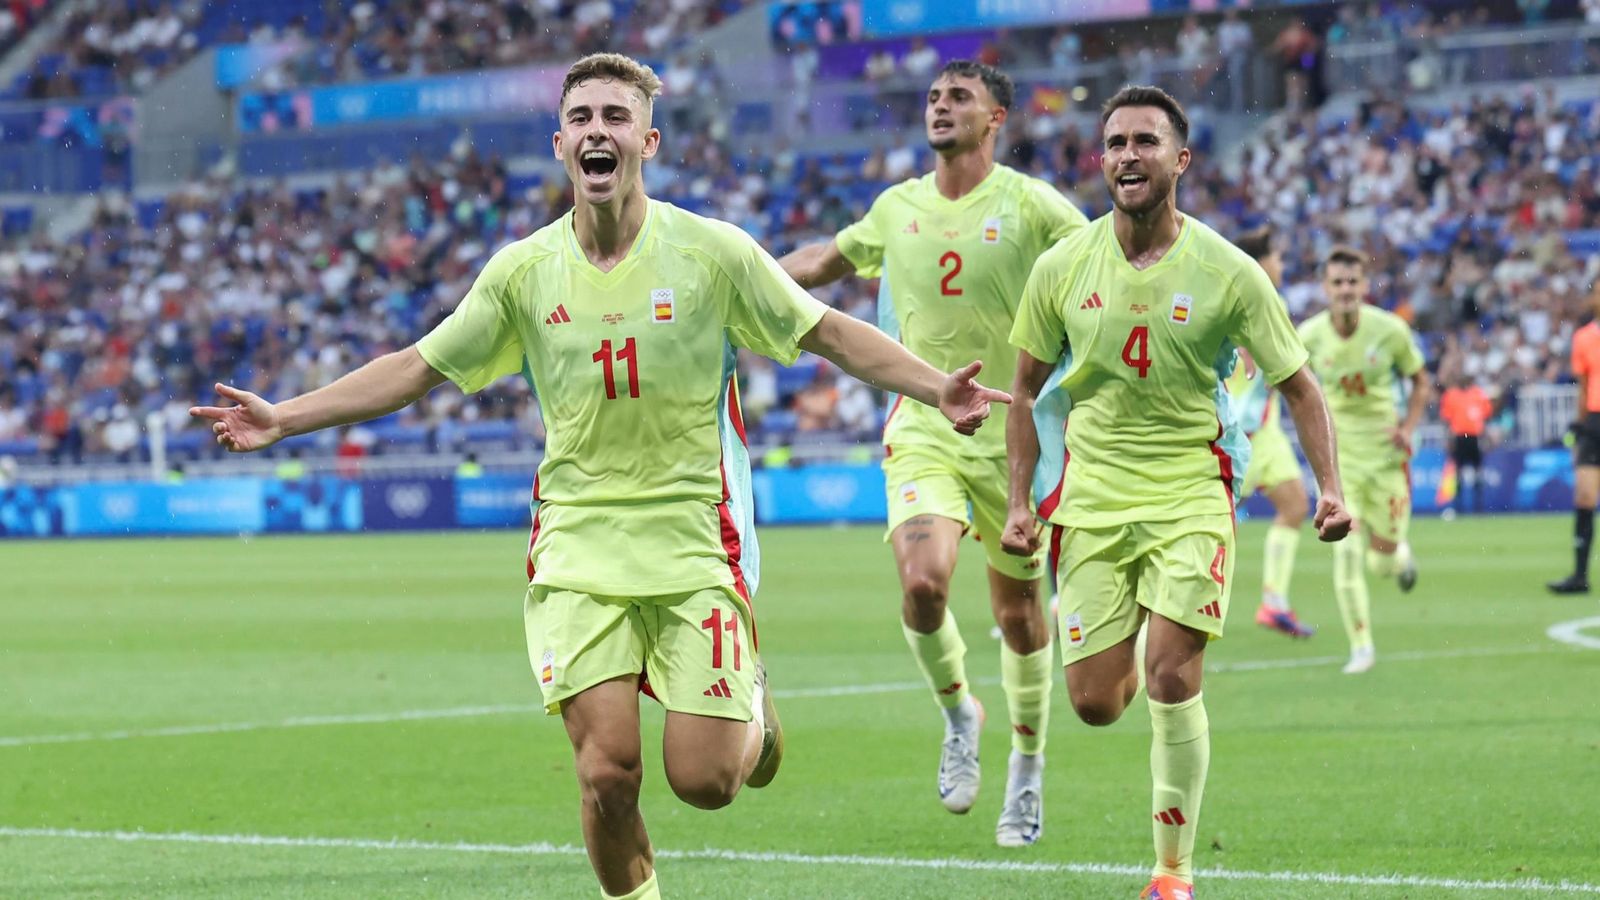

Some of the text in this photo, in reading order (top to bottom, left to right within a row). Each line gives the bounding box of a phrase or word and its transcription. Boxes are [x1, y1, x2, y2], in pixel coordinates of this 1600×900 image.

[939, 251, 963, 296] 2
[592, 337, 640, 400] 11
[1121, 326, 1152, 378] 4
[1340, 372, 1367, 398] 14
[1210, 545, 1226, 597] 4
[702, 608, 741, 671] 11
